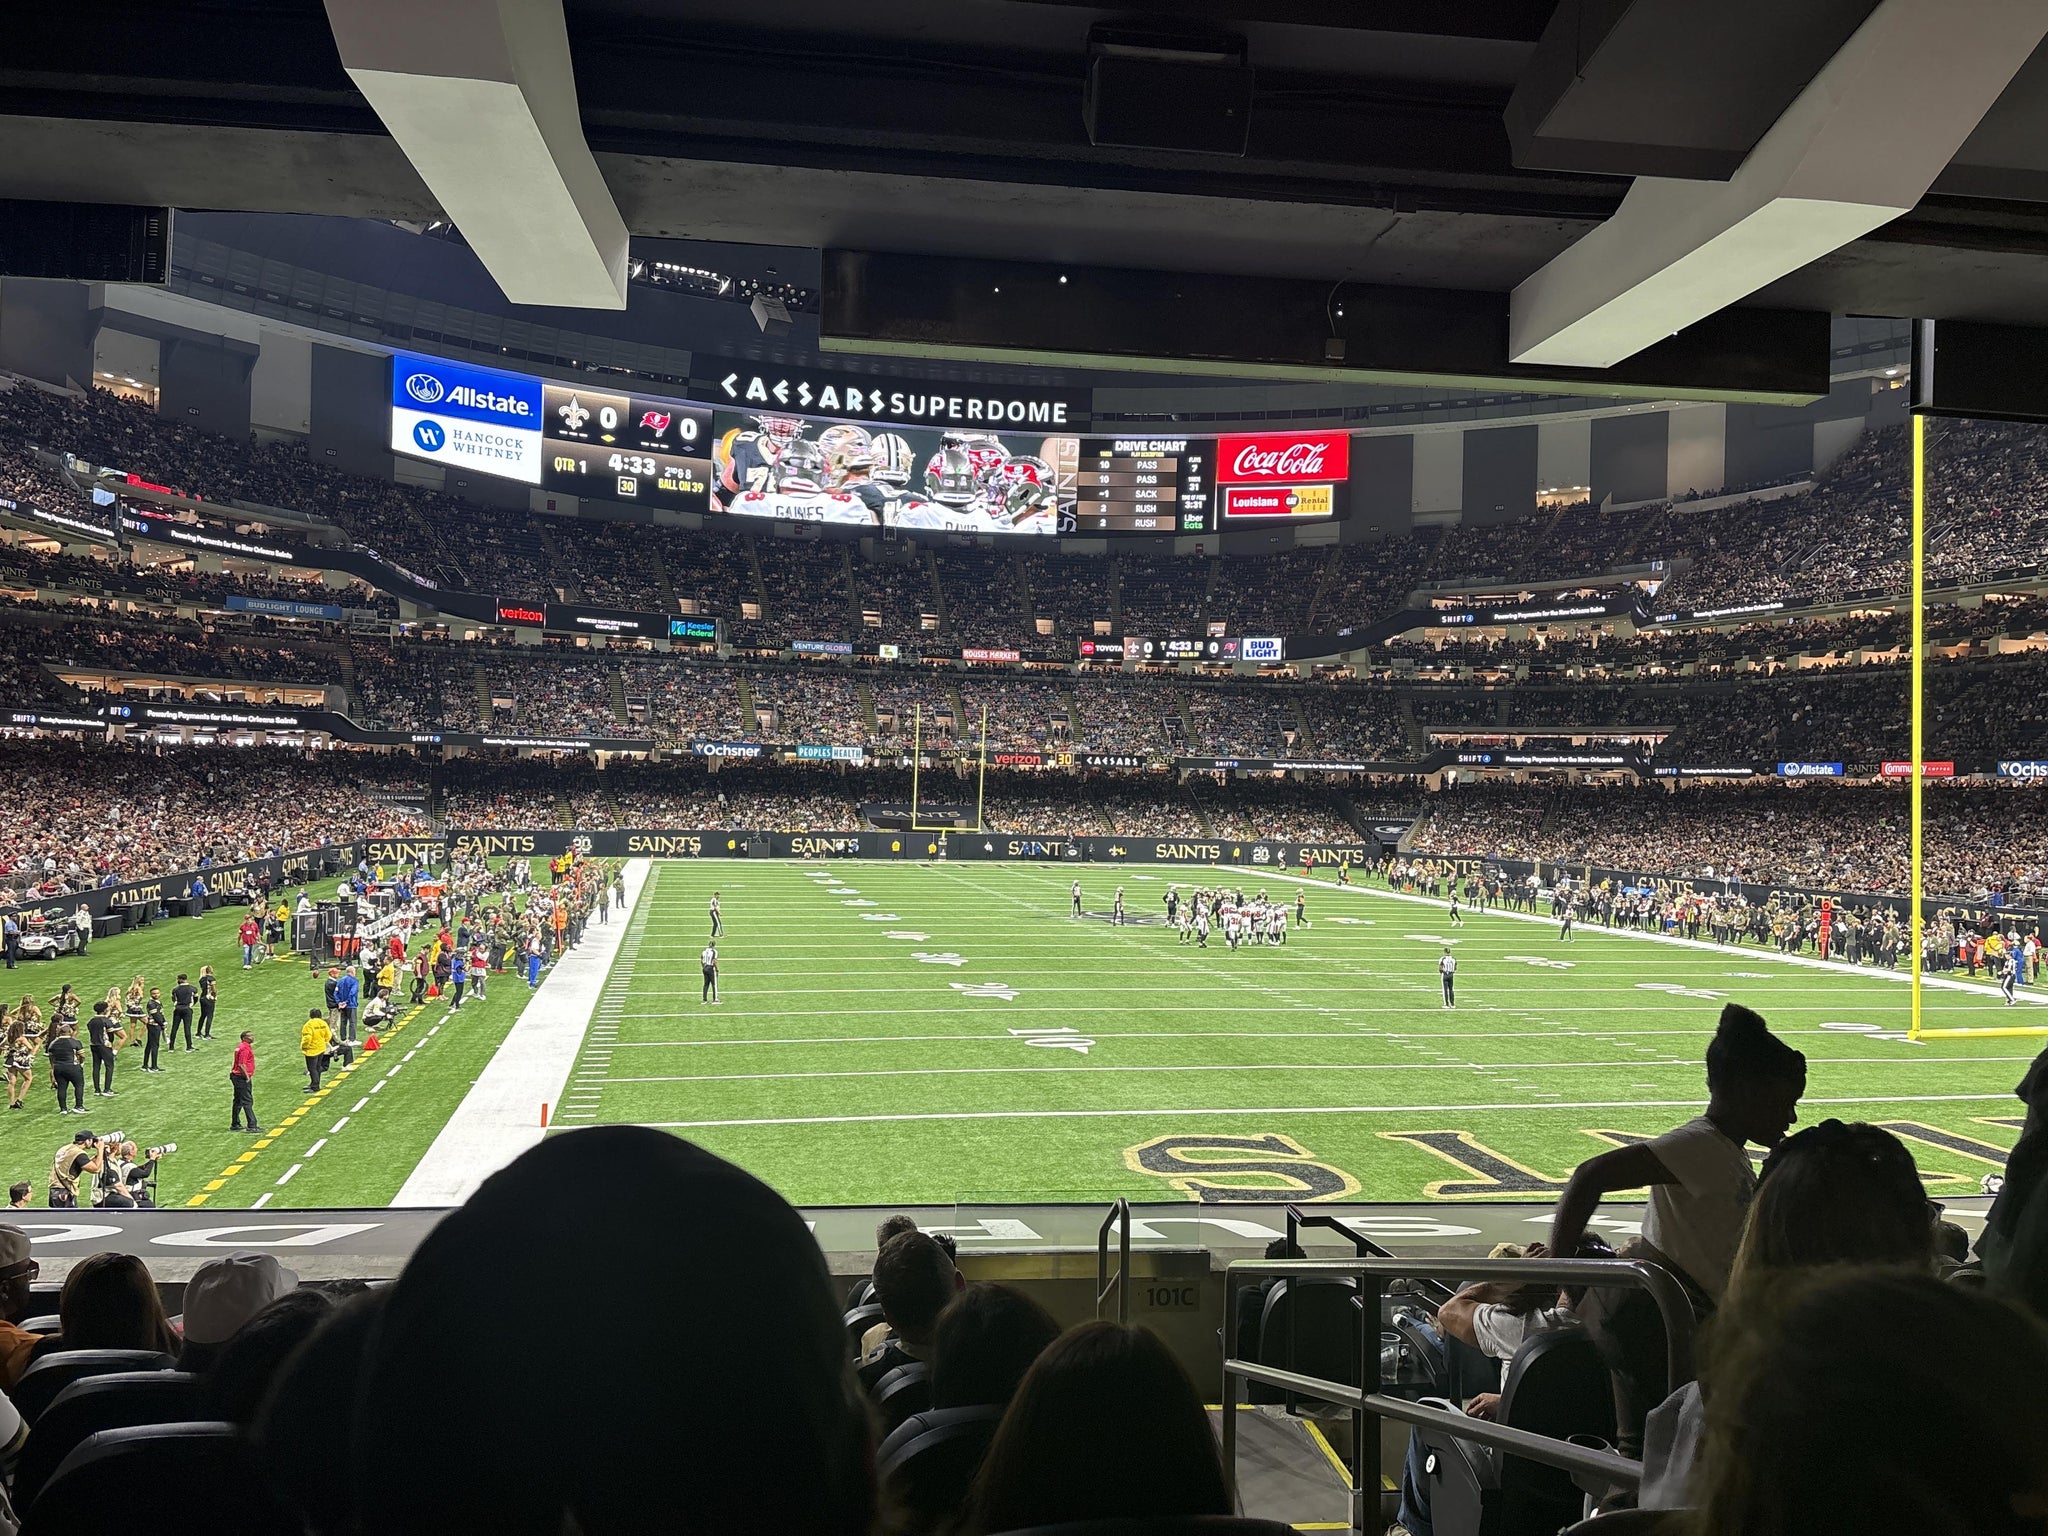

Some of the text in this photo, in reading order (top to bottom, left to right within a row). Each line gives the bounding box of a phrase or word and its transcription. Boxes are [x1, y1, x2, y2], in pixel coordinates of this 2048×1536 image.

[446, 385, 529, 416] Allstate
[721, 373, 1066, 424] CAESARS SUPERDOME
[600, 407, 617, 428] 0
[680, 418, 697, 440] 0
[453, 430, 524, 449] HANCOCK
[454, 443, 523, 461] WHITNEY
[1115, 441, 1186, 451] DRIVE CHART
[554, 457, 586, 474] QTR 1
[608, 454, 656, 475] 4:33
[1137, 461, 1158, 469] PASS
[1234, 443, 1330, 476] Coca-Cola
[622, 480, 633, 492] 30
[658, 478, 678, 490] BALL
[692, 482, 704, 492] 39
[1058, 441, 1078, 532] SAINTS
[1185, 501, 1202, 509] 3:31
[1232, 496, 1278, 507] Louisiana
[68, 577, 102, 588] SAINTS
[1957, 573, 1994, 586] SAINTS
[146, 587, 181, 600] SAINTS
[1883, 584, 1914, 596] SAINT
[1812, 594, 1844, 605] SAINTS
[268, 603, 290, 612] LIGHT
[296, 605, 324, 616] LOUNGE
[500, 608, 542, 622] verizon
[1494, 613, 1517, 621] Powering
[1518, 611, 1541, 619] Payments
[687, 621, 715, 630] Keesler
[1972, 624, 2006, 636] SAINTS
[687, 630, 714, 638] Federal
[793, 642, 852, 652] VENTURE GLOBAL
[1144, 642, 1153, 653] 0
[1169, 641, 1192, 651] 4:33
[1209, 642, 1219, 654] 0
[1760, 645, 1788, 654] SAINTS
[1826, 639, 1858, 649] SAINTS
[964, 650, 1020, 660] ROUSES MARKETS
[1246, 649, 1278, 658] LIGHT
[1632, 654, 1661, 662] SAINTS
[1698, 650, 1726, 658] SAINTS
[147, 710, 177, 721] Powering
[178, 712, 209, 723] Payments
[654, 741, 688, 750] SAINTS
[704, 744, 760, 758] Ochsner
[799, 746, 861, 758] PEOPLES HEALTH
[994, 753, 1041, 764] verizon
[1058, 754, 1071, 764] 30
[1086, 756, 1138, 766] CAESARS
[1799, 764, 1834, 775] Allstate
[1848, 764, 1879, 772] SAINTS
[1885, 763, 1927, 775] Commuy
[882, 810, 960, 818] SAINTS
[456, 835, 534, 852] SAINTS
[628, 836, 701, 854] SAINTS
[792, 837, 858, 854] SAINTS
[1008, 840, 1068, 856] SAINT
[368, 842, 444, 861] SAINTS
[1156, 844, 1220, 860] SAINTS
[1300, 848, 1364, 864] SAINTS
[211, 867, 246, 896] SAINTS
[1638, 876, 1694, 896] SAINTS
[1147, 1287, 1194, 1306] 101C
